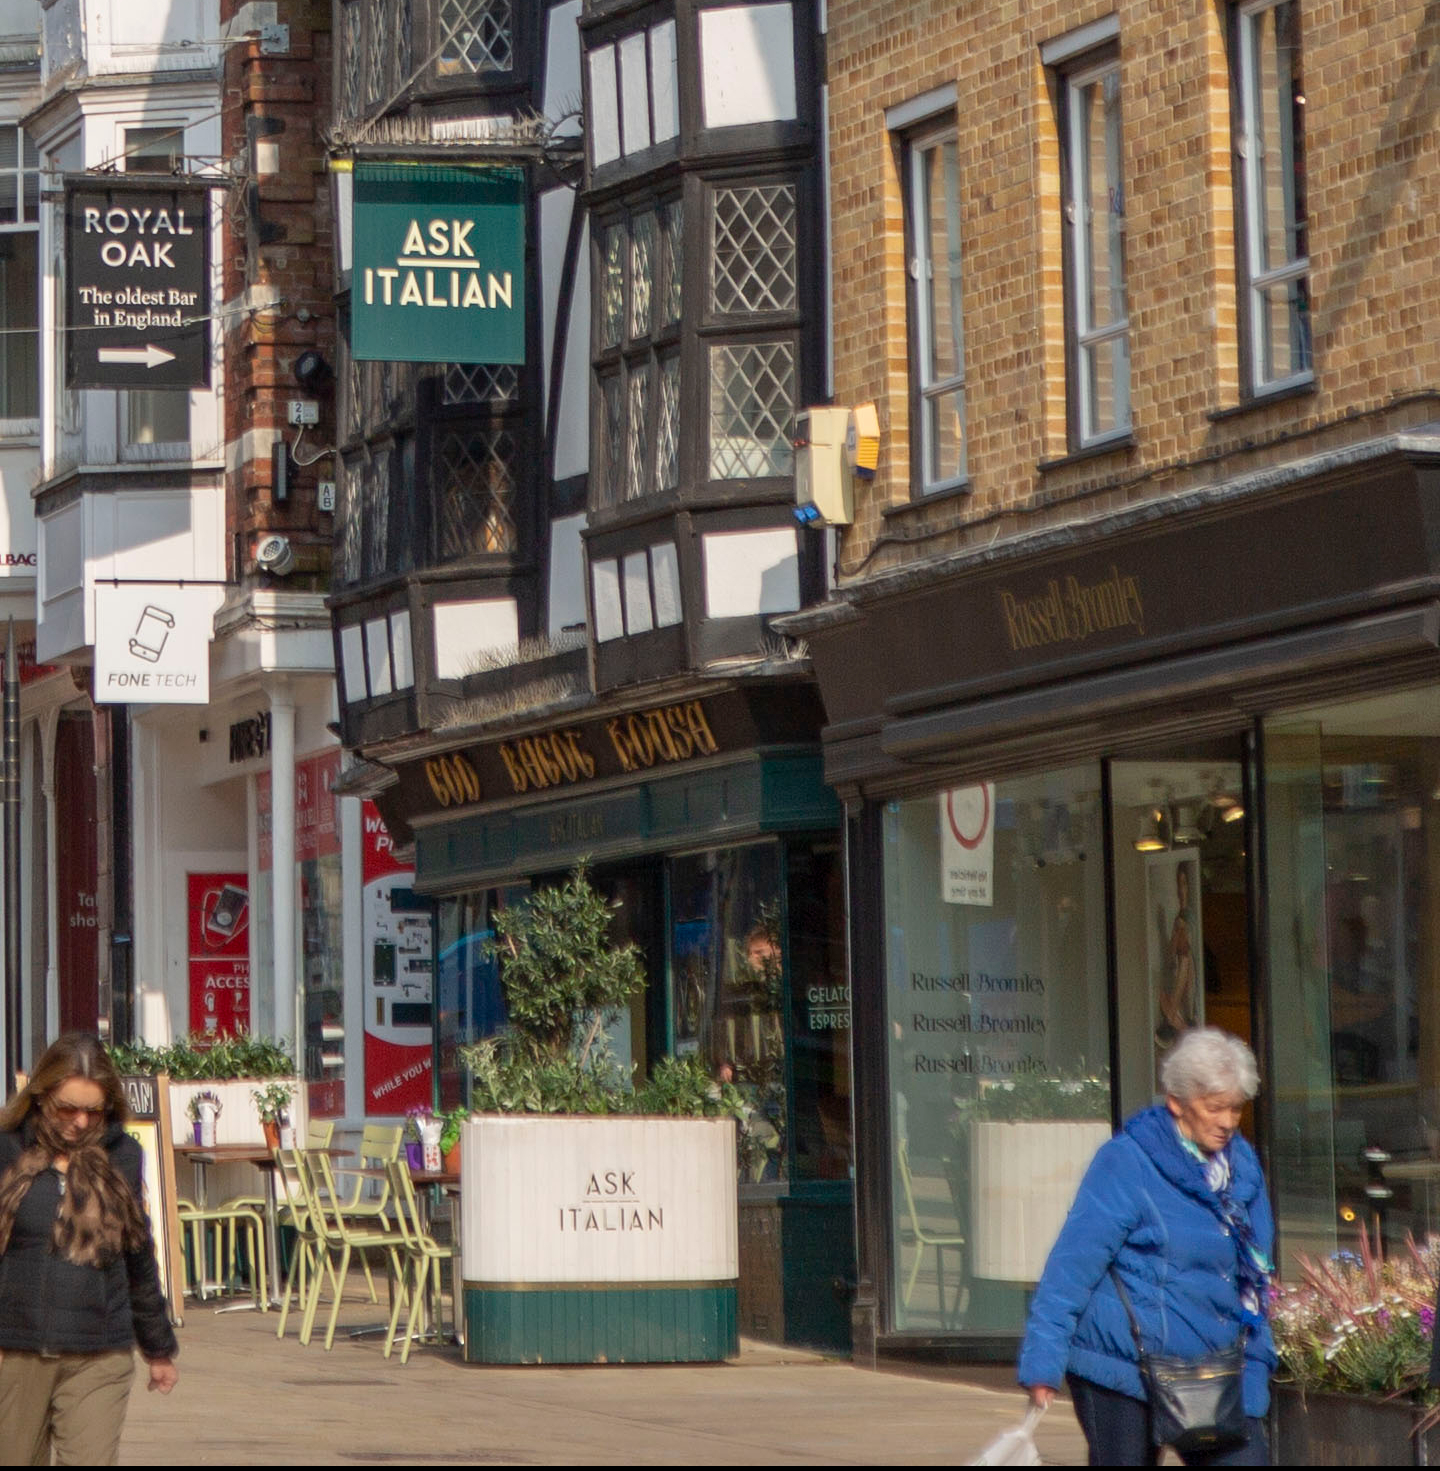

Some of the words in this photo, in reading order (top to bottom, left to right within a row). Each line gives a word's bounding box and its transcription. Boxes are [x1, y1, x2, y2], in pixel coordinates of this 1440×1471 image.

[84, 208, 193, 235] ROYAL
[402, 219, 475, 257] ASK
[101, 240, 175, 268] OAK
[78, 286, 112, 304] The
[115, 286, 165, 305] oldest
[168, 289, 198, 306] Bar
[364, 268, 513, 310] ITALIAN
[94, 308, 110, 326] in
[113, 308, 182, 330] England
[107, 673, 151, 687] FONE
[155, 673, 197, 687] TECH
[372, 1075, 405, 1100] WHILE
[404, 1064, 424, 1082] YOU
[586, 1171, 636, 1196] ASK
[559, 1207, 664, 1232] ITALIAN
